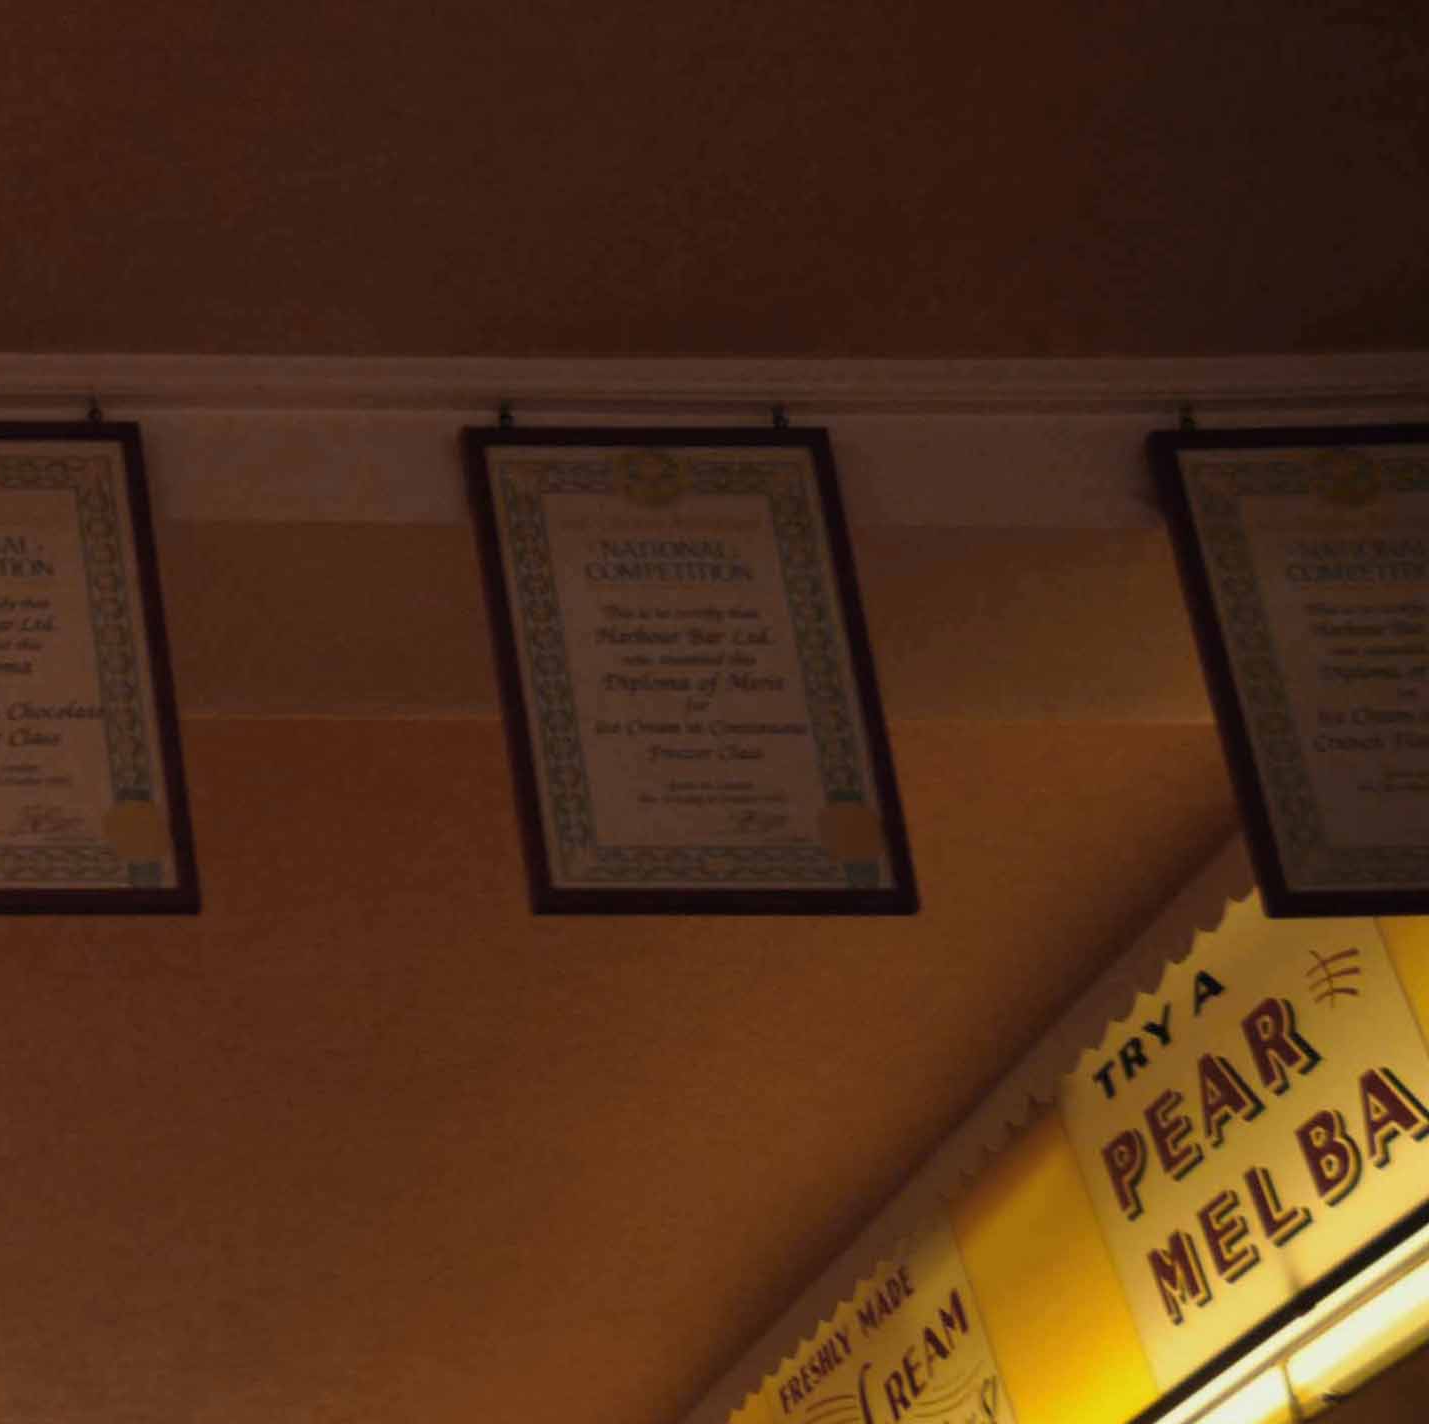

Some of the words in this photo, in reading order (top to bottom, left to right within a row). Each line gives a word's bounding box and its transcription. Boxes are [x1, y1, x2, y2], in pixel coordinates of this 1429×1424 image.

[1093, 1015, 1175, 1099] TRY
[1188, 969, 1224, 1012] A
[1098, 996, 1322, 1222] PEAR
[1146, 1065, 1429, 1326] MELBA
[776, 1333, 852, 1415] FRESHLY
[858, 1266, 914, 1334] MADE
